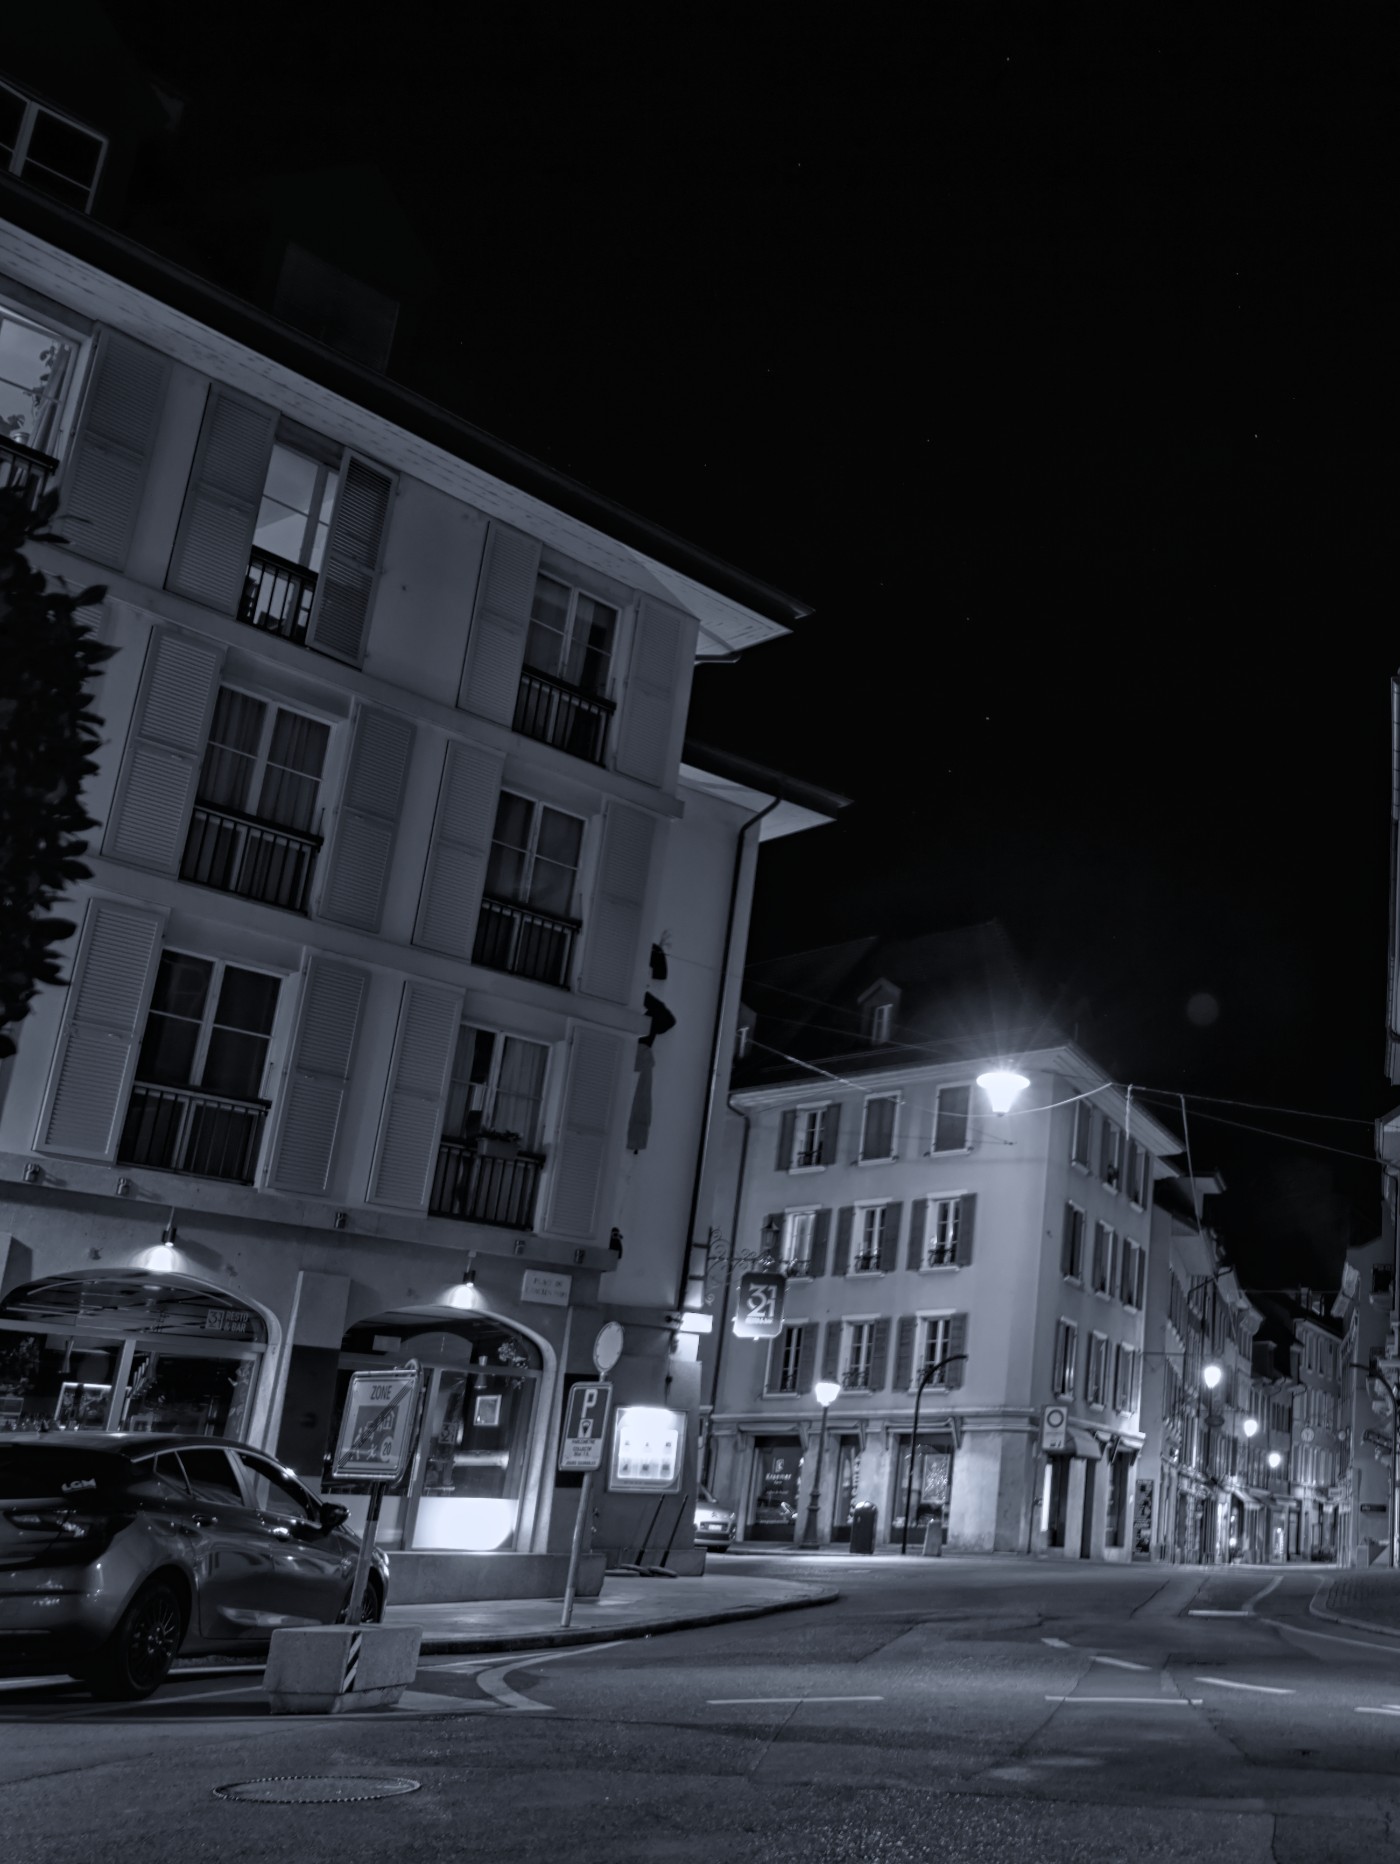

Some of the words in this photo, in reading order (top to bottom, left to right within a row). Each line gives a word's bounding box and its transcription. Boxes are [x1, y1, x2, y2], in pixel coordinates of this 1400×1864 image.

[231, 1322, 247, 1333] BAR
[370, 1385, 393, 1401] ZONE
[580, 1388, 599, 1419] P
[382, 1441, 392, 1457] 20
